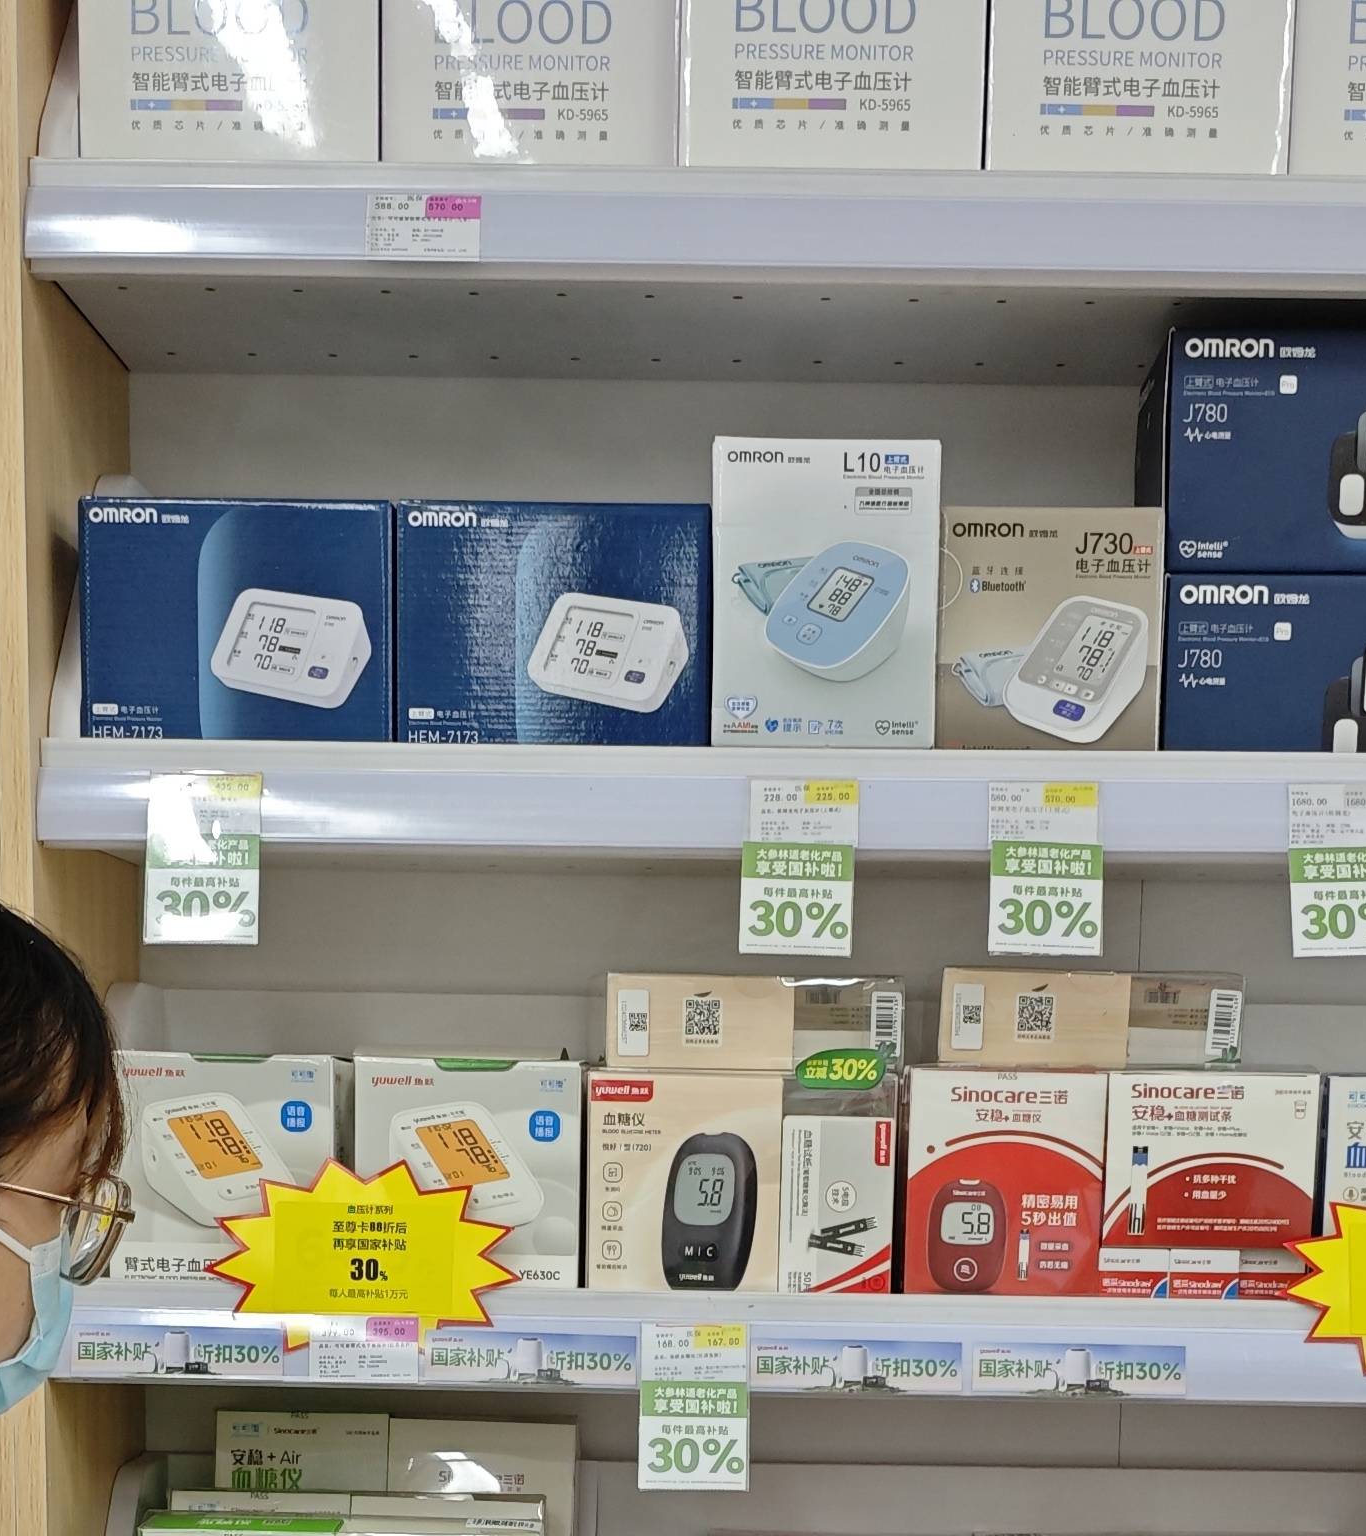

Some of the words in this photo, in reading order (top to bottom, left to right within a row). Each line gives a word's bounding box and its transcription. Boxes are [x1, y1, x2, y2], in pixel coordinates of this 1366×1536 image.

[1043, 49, 1134, 67] PRESSURE
[1139, 51, 1222, 69] MONITOR
[735, 70, 913, 92] 智能臂式电子血压计
[1043, 77, 1220, 99] 智能臂式电子血压计
[1167, 104, 1219, 119] KD-5965
[374, 202, 410, 211] 588.00
[428, 203, 464, 212] 570.00
[1183, 403, 1228, 423] J780
[727, 450, 784, 463] OMRON
[843, 452, 881, 473] L10
[408, 510, 477, 528] OMRON
[952, 522, 1024, 538] OMRON
[1075, 533, 1134, 556] J730
[1075, 558, 1151, 574] 电子血压计
[981, 579, 1025, 593] Bluetooth
[1180, 585, 1269, 605] OMRON
[258, 615, 285, 634] 118
[257, 636, 279, 653] 78
[1177, 649, 1222, 668] J780
[408, 729, 479, 744] HEM-7173
[1291, 796, 1328, 807] 1680.00
[748, 900, 850, 939] 30%
[951, 1085, 1069, 1105] Sinocare三诺
[603, 1113, 646, 1127] 血糖仪
[347, 1204, 393, 1215] 血压计系列
[1021, 1194, 1078, 1210] 精密易用
[962, 1211, 991, 1235] 5.8
[1021, 1211, 1077, 1227] 5秒出值
[333, 1220, 407, 1235] 至尊卡88折后
[333, 1237, 407, 1251] 再享国家补贴
[519, 1270, 560, 1281] YE630C
[329, 1288, 409, 1300] 每人最高补贴1万元
[647, 1437, 744, 1475] 30%
